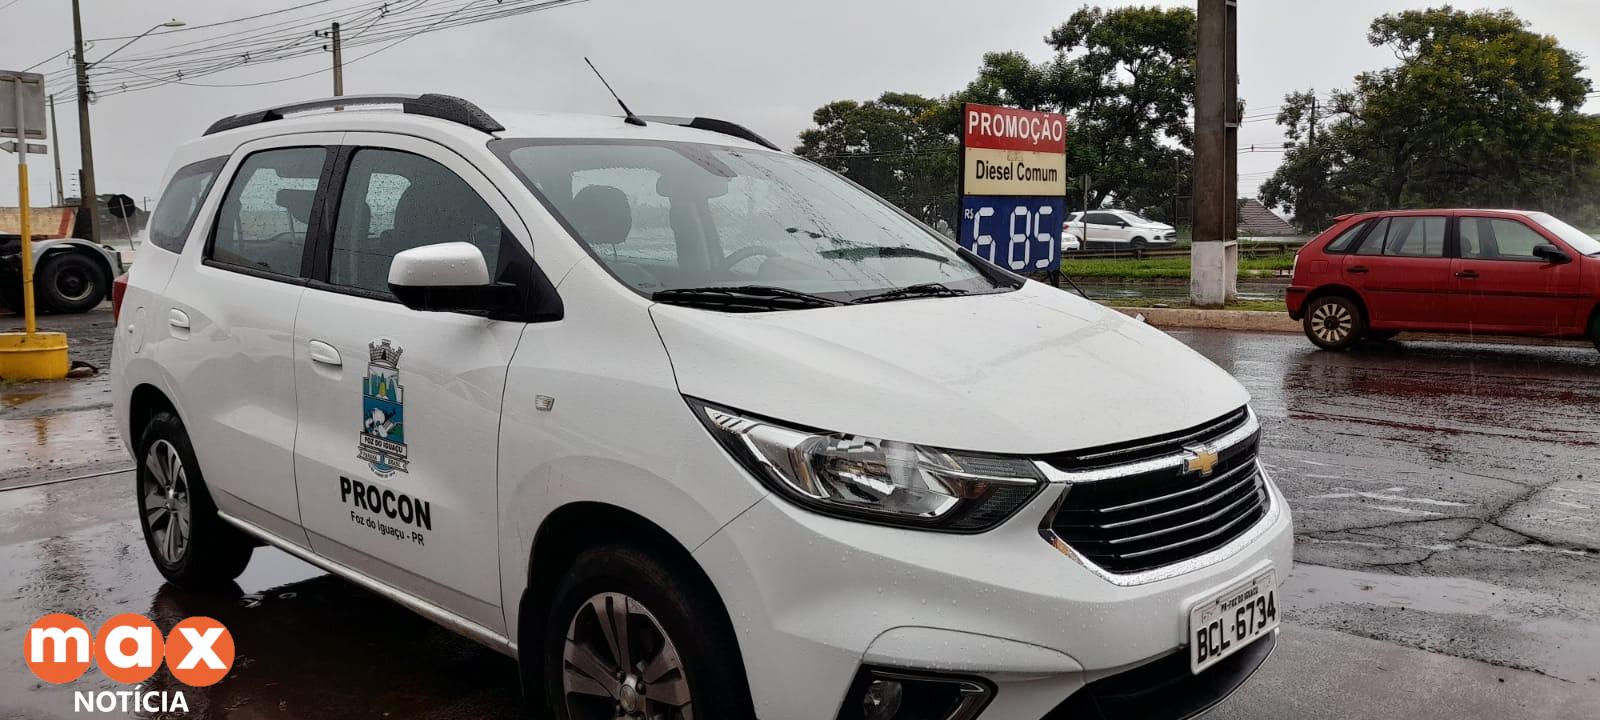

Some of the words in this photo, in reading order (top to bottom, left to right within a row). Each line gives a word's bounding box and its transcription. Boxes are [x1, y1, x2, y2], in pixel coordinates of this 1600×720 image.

[968, 111, 1062, 145] PROMOÇÃO
[976, 160, 1013, 180] Diesel
[1017, 162, 1057, 182] Comum
[964, 208, 974, 220] R$
[364, 436, 374, 445] FOZ
[374, 439, 383, 448] DO
[340, 476, 431, 531] PROCON
[351, 511, 365, 526] Foz
[366, 516, 376, 529] do
[378, 520, 405, 541] Iguaçu
[411, 531, 424, 547] PR
